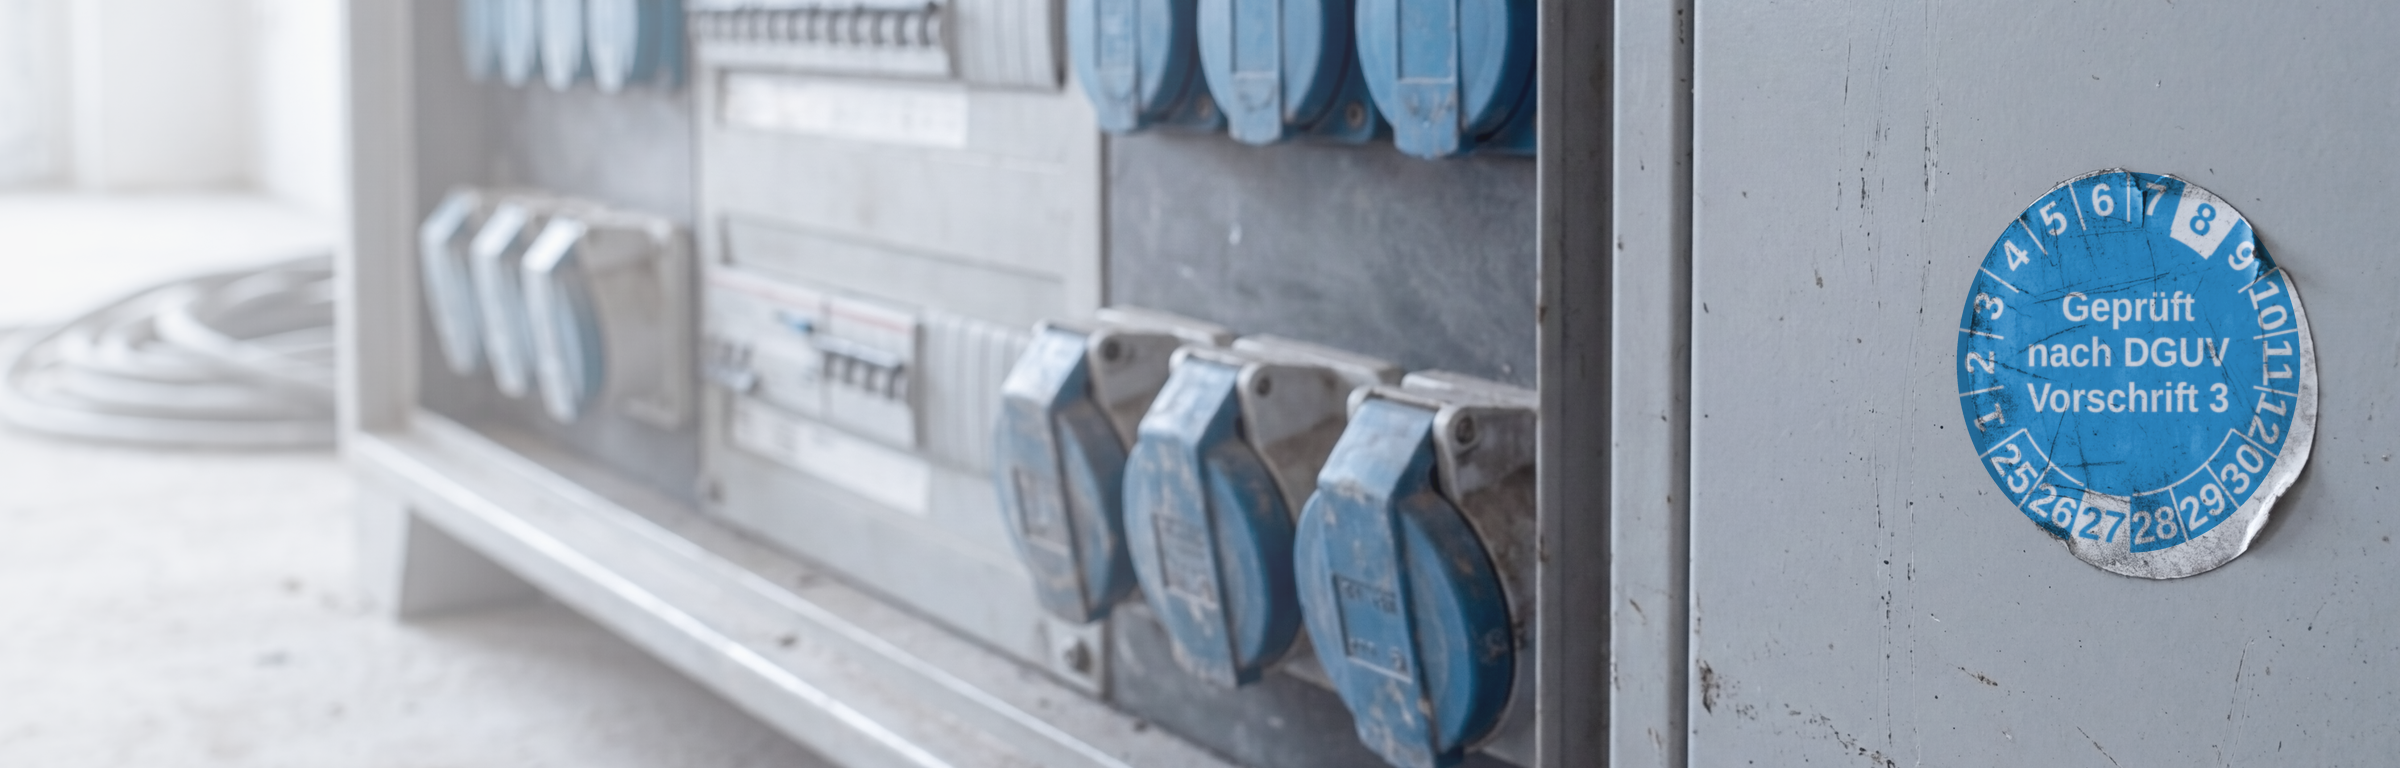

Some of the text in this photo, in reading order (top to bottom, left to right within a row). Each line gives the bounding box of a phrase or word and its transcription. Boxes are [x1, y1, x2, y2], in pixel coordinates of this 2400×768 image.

[2091, 183, 2115, 216] 6
[2144, 182, 2167, 216] 7
[2039, 201, 2068, 236] 5
[2189, 203, 2217, 236] 8
[2001, 239, 2031, 272] 4
[2227, 241, 2257, 271] 9
[1973, 292, 2004, 320] 3
[2062, 291, 2195, 329] Geprüft
[2248, 280, 2288, 330] 10
[1965, 350, 1995, 375] 2
[2028, 337, 2230, 367] nach DGUV
[2263, 340, 2292, 385] 11
[2027, 382, 2229, 413] Vorschrift 3
[1974, 404, 2005, 432] 1
[2248, 391, 2287, 445] 12
[1990, 443, 2039, 494] 25
[2221, 444, 2264, 495] 30
[2028, 482, 2077, 529] 26
[2180, 483, 2226, 532] 29
[2078, 510, 2127, 543] 27
[2132, 507, 2177, 545] 28
